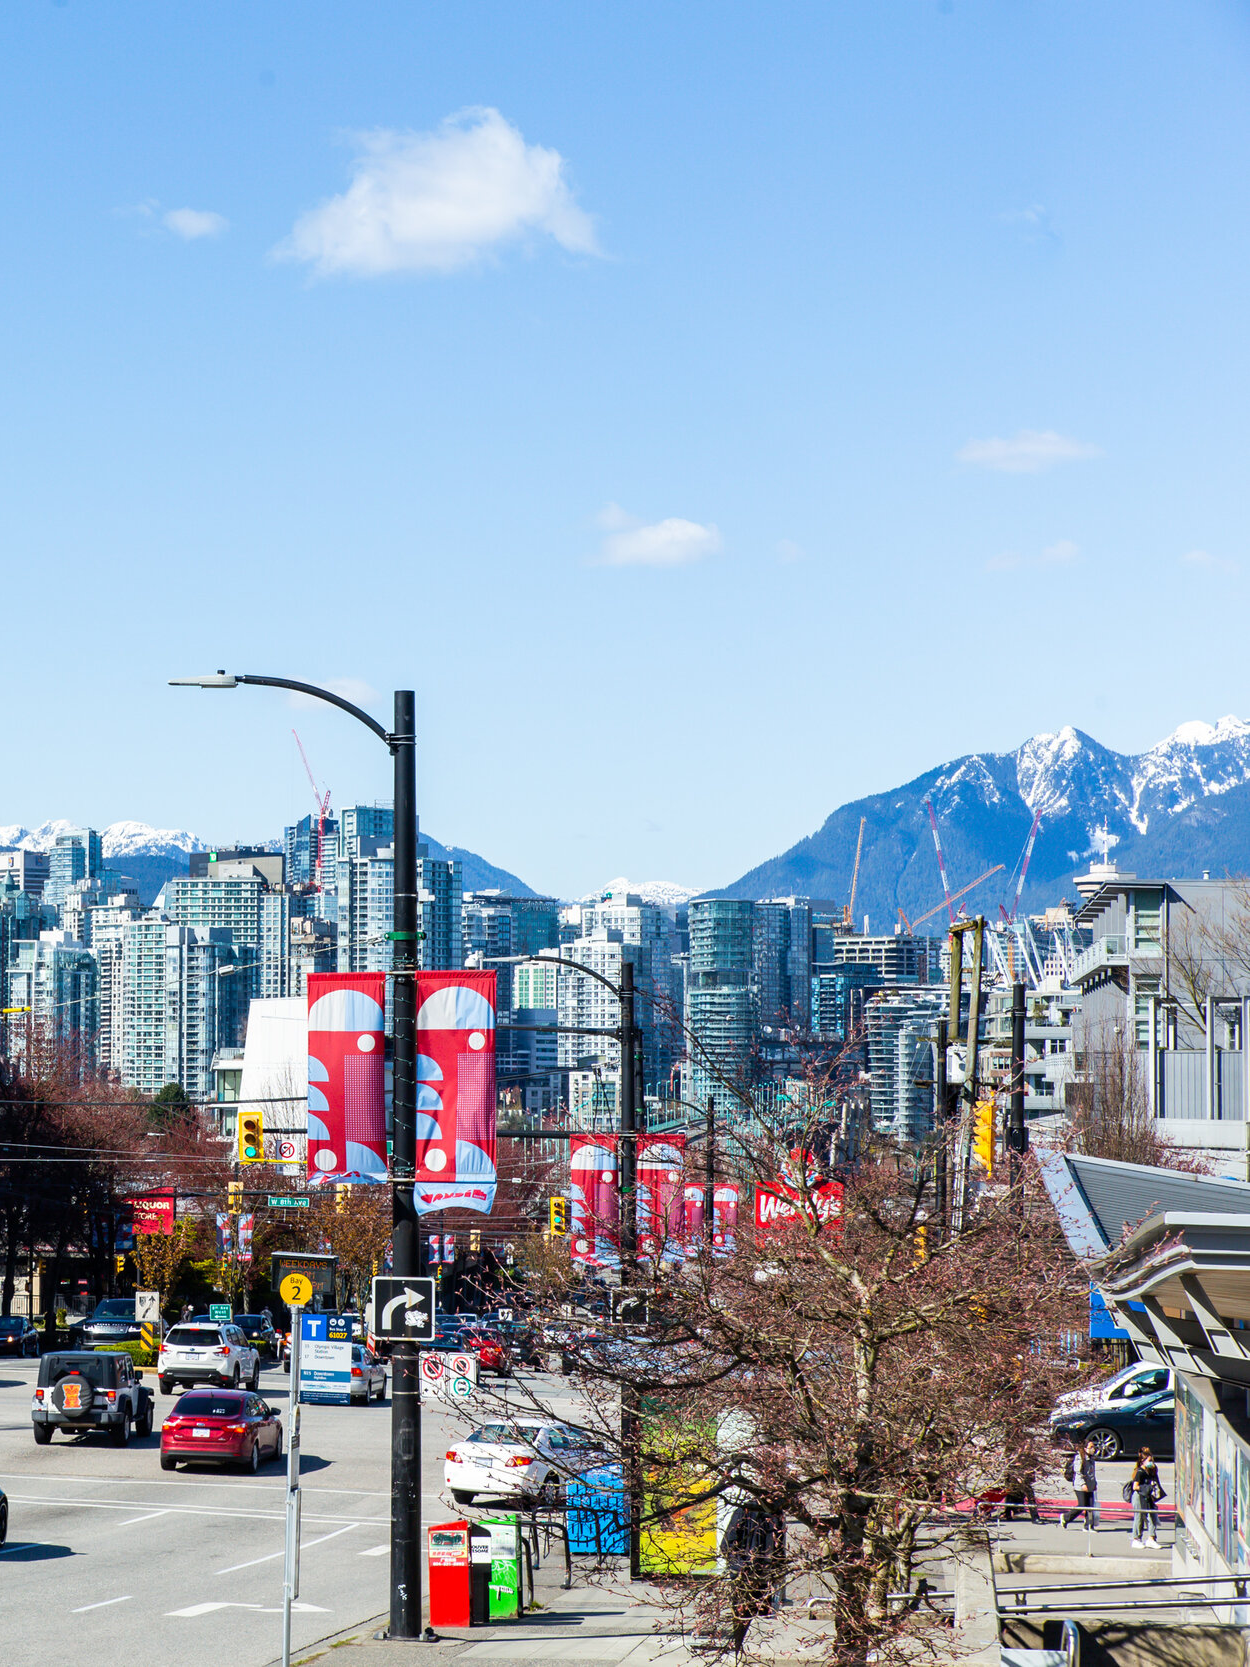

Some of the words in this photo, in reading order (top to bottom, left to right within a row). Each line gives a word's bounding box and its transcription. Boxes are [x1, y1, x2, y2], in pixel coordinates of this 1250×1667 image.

[280, 1260, 327, 1270] WEEKDAYS
[290, 1277, 304, 1285] Bay
[292, 1286, 301, 1300] 2
[307, 1320, 321, 1337] T
